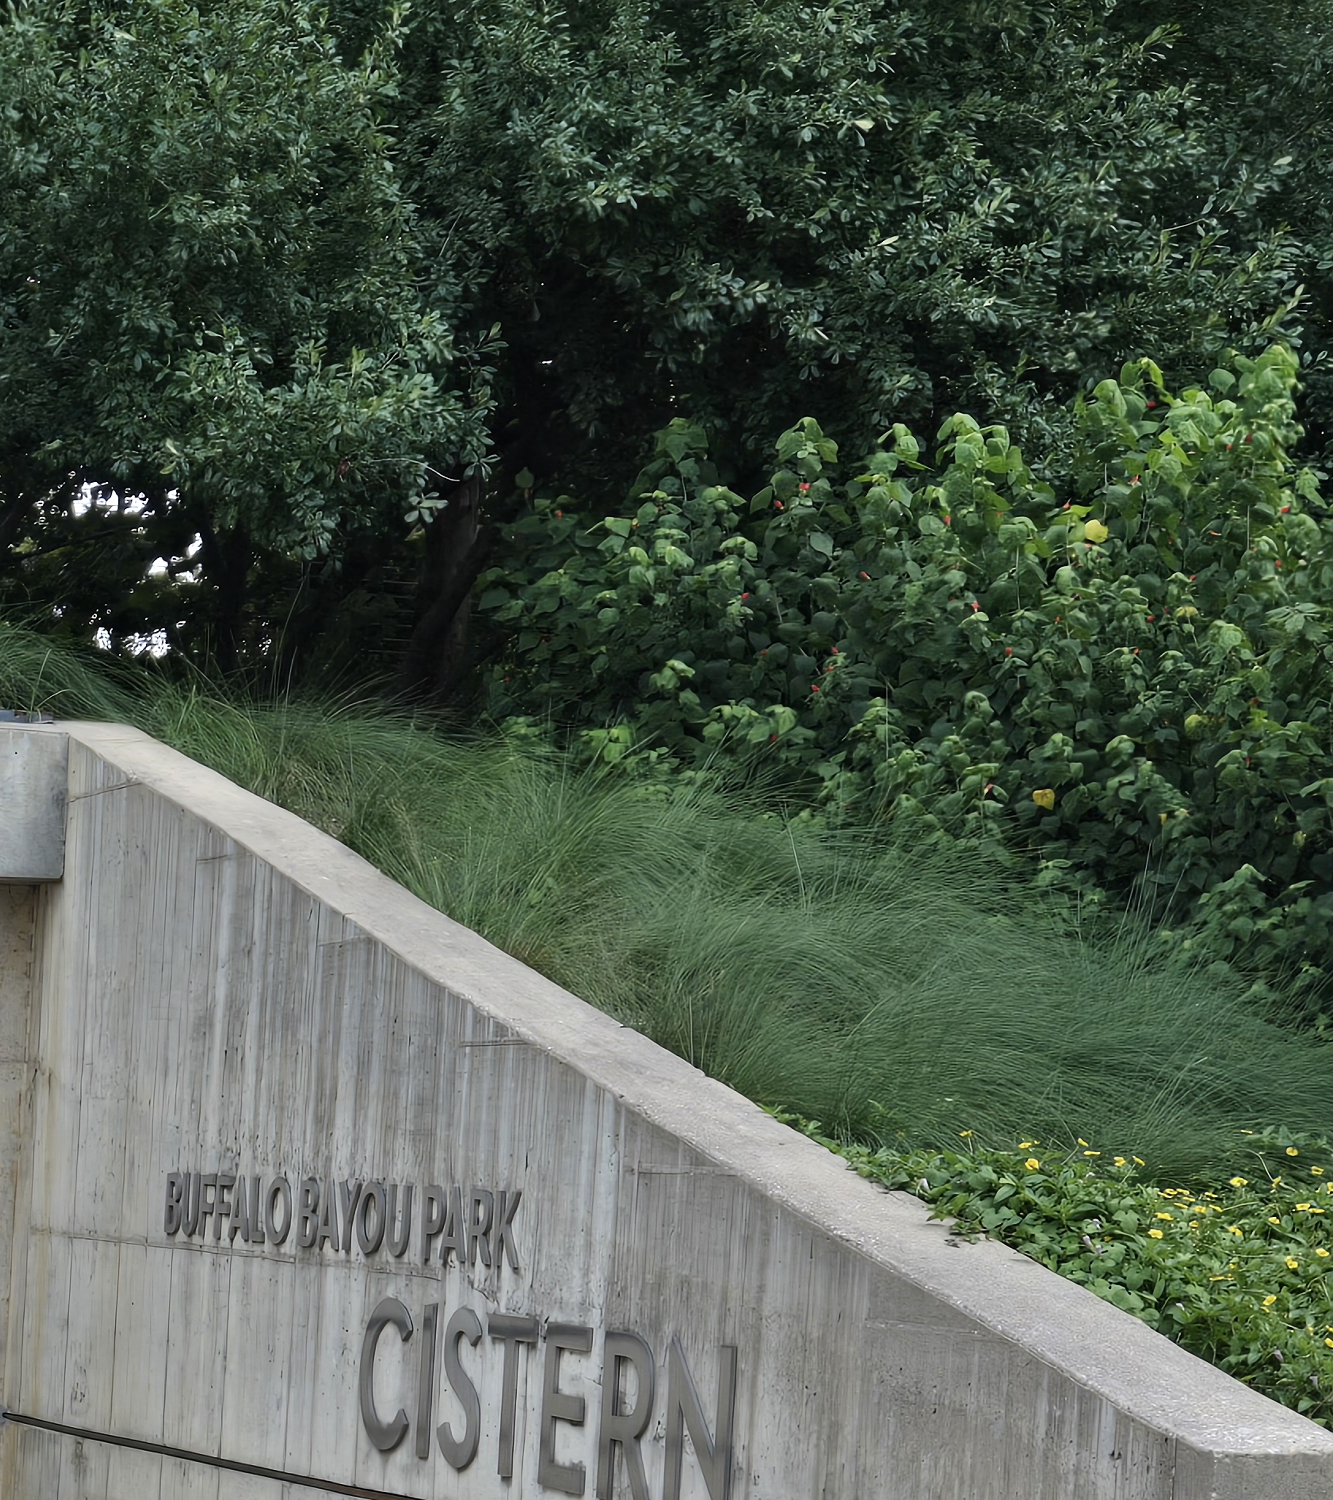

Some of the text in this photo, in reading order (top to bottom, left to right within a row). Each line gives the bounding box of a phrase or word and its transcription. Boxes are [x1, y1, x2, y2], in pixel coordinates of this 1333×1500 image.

[164, 1171, 523, 1272] BUFFALO BAYOU PARK
